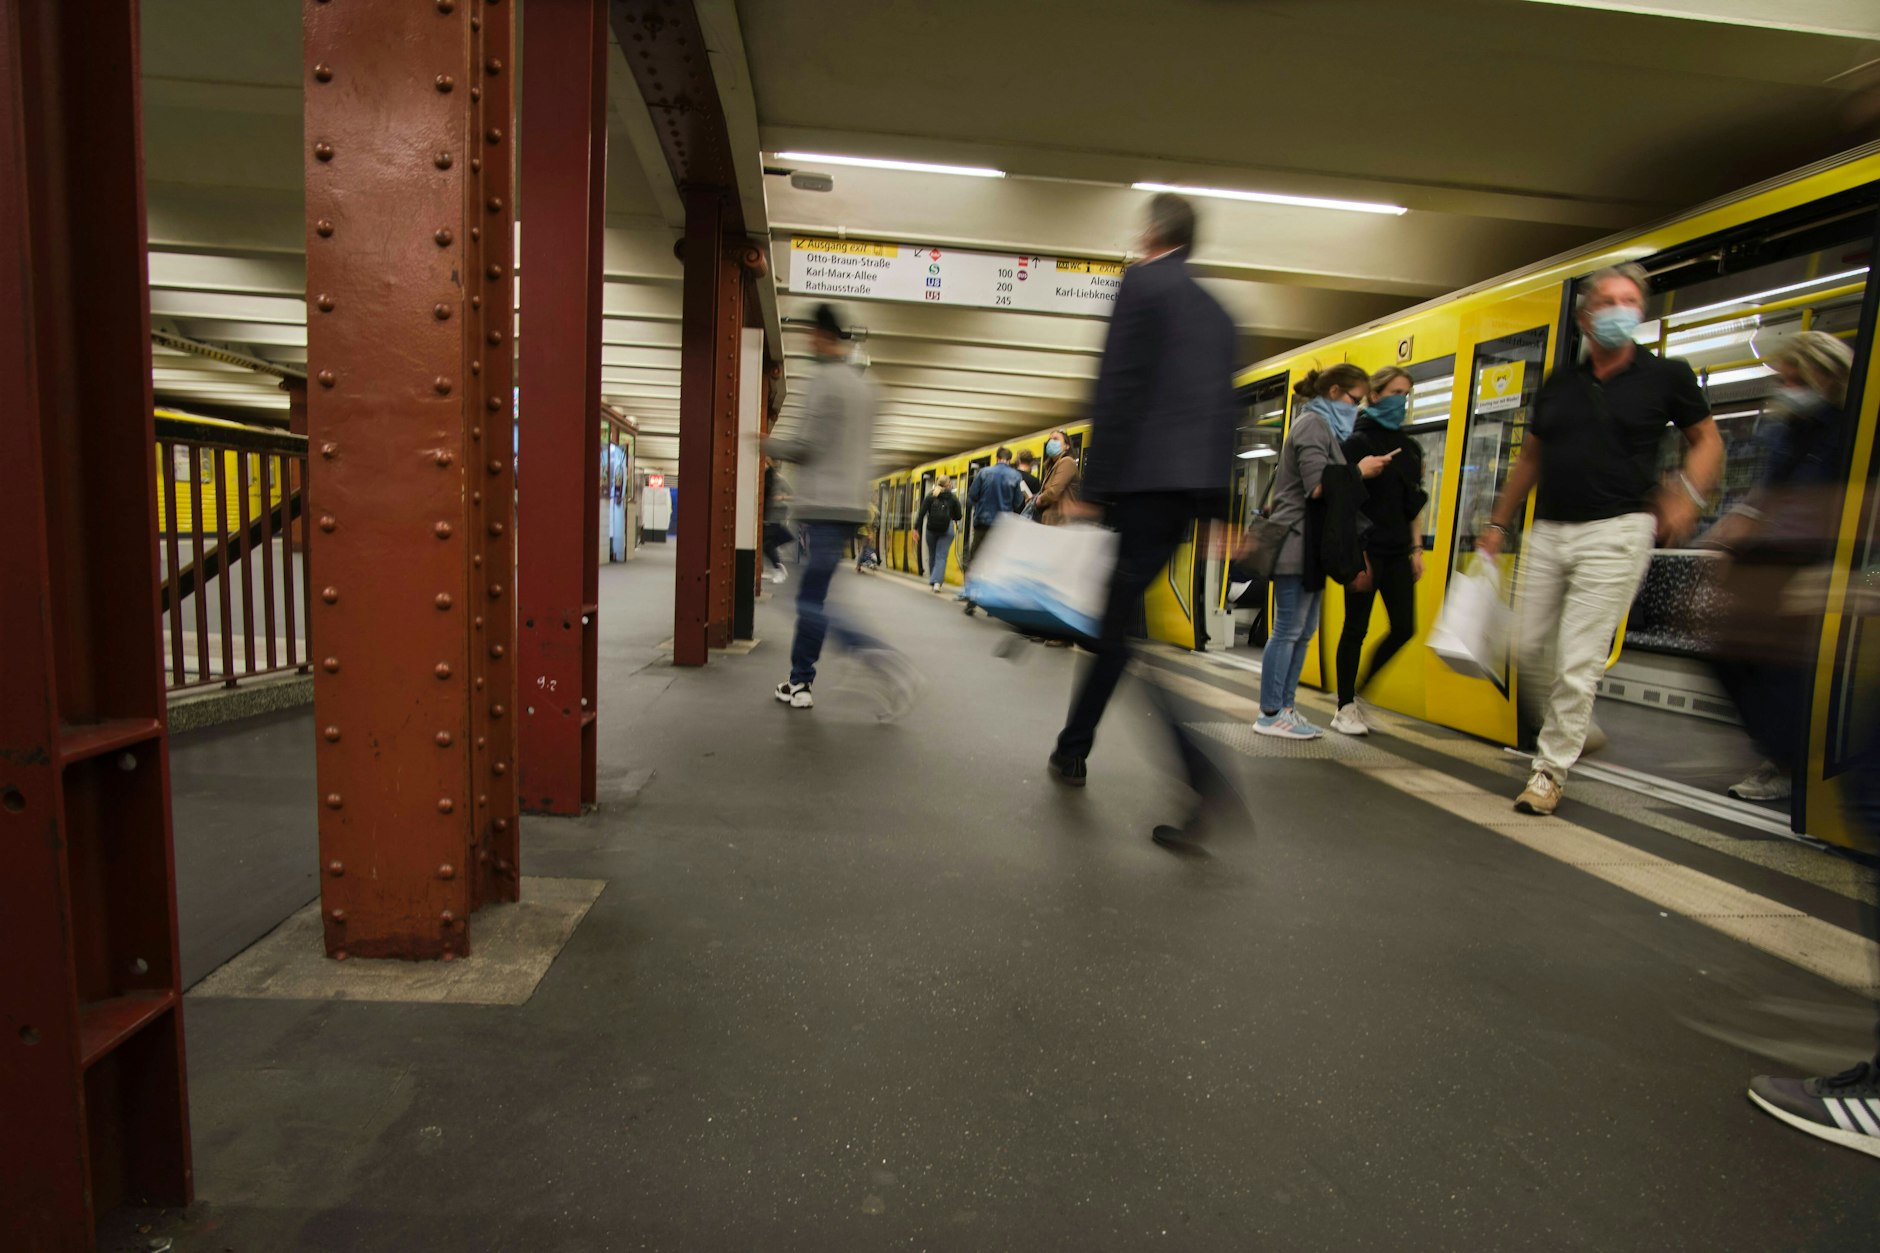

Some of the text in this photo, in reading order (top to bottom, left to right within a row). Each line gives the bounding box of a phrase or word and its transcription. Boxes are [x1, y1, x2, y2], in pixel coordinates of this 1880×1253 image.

[807, 240, 867, 253] Ausgang exit
[807, 252, 891, 269] Otto-Braun-Straße
[806, 266, 878, 282] Karl-Marx-Allee
[998, 268, 1013, 279] 100
[1099, 264, 1116, 273] exit
[805, 281, 871, 295] Rathausstraße
[996, 282, 1013, 292] 200
[995, 296, 1012, 306] 245
